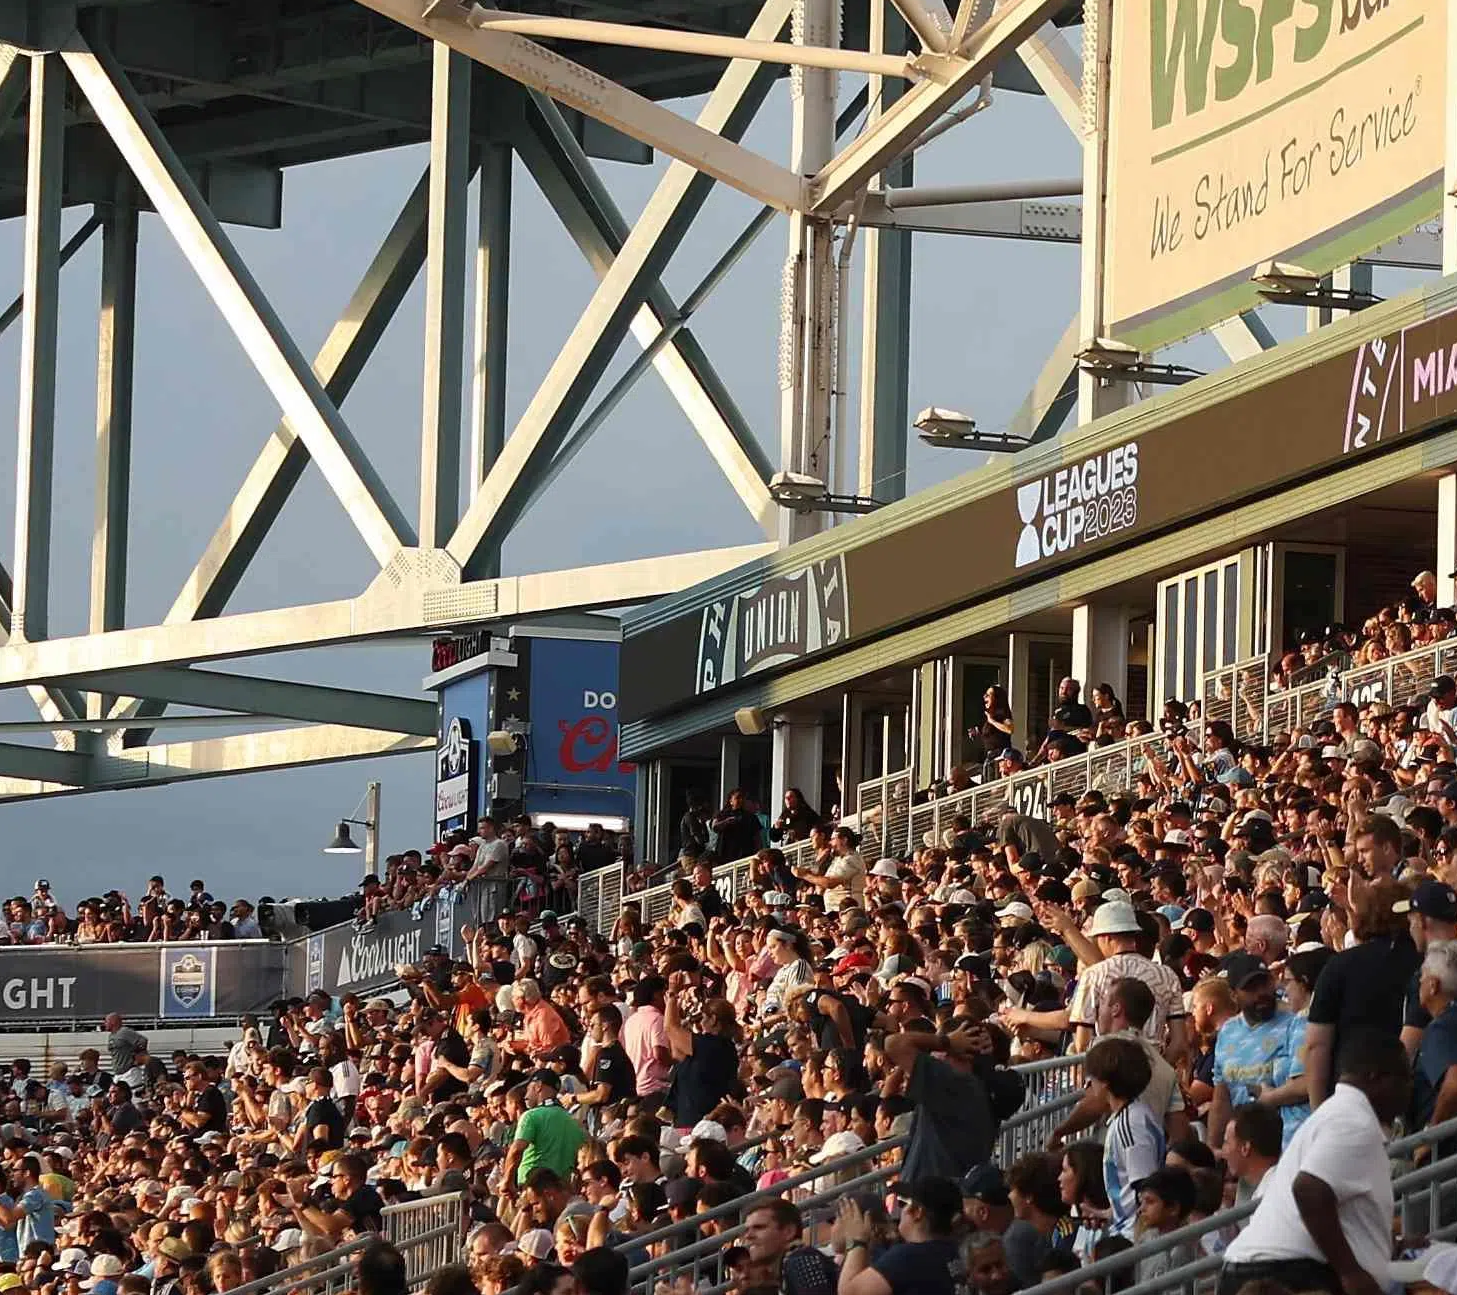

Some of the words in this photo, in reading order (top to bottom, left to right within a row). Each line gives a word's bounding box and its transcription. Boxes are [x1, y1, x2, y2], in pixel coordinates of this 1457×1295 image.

[1150, 195, 1184, 260] We
[1194, 151, 1272, 241] Stand
[1280, 137, 1321, 203] For
[1330, 88, 1415, 176] Service
[1042, 441, 1139, 516] LEAGUES
[1041, 507, 1084, 558] CUP
[1083, 484, 1137, 543] 2023
[744, 590, 801, 665] UNION
[1013, 782, 1044, 820] 124
[351, 934, 387, 983] Coors
[388, 929, 422, 971] LIGHT
